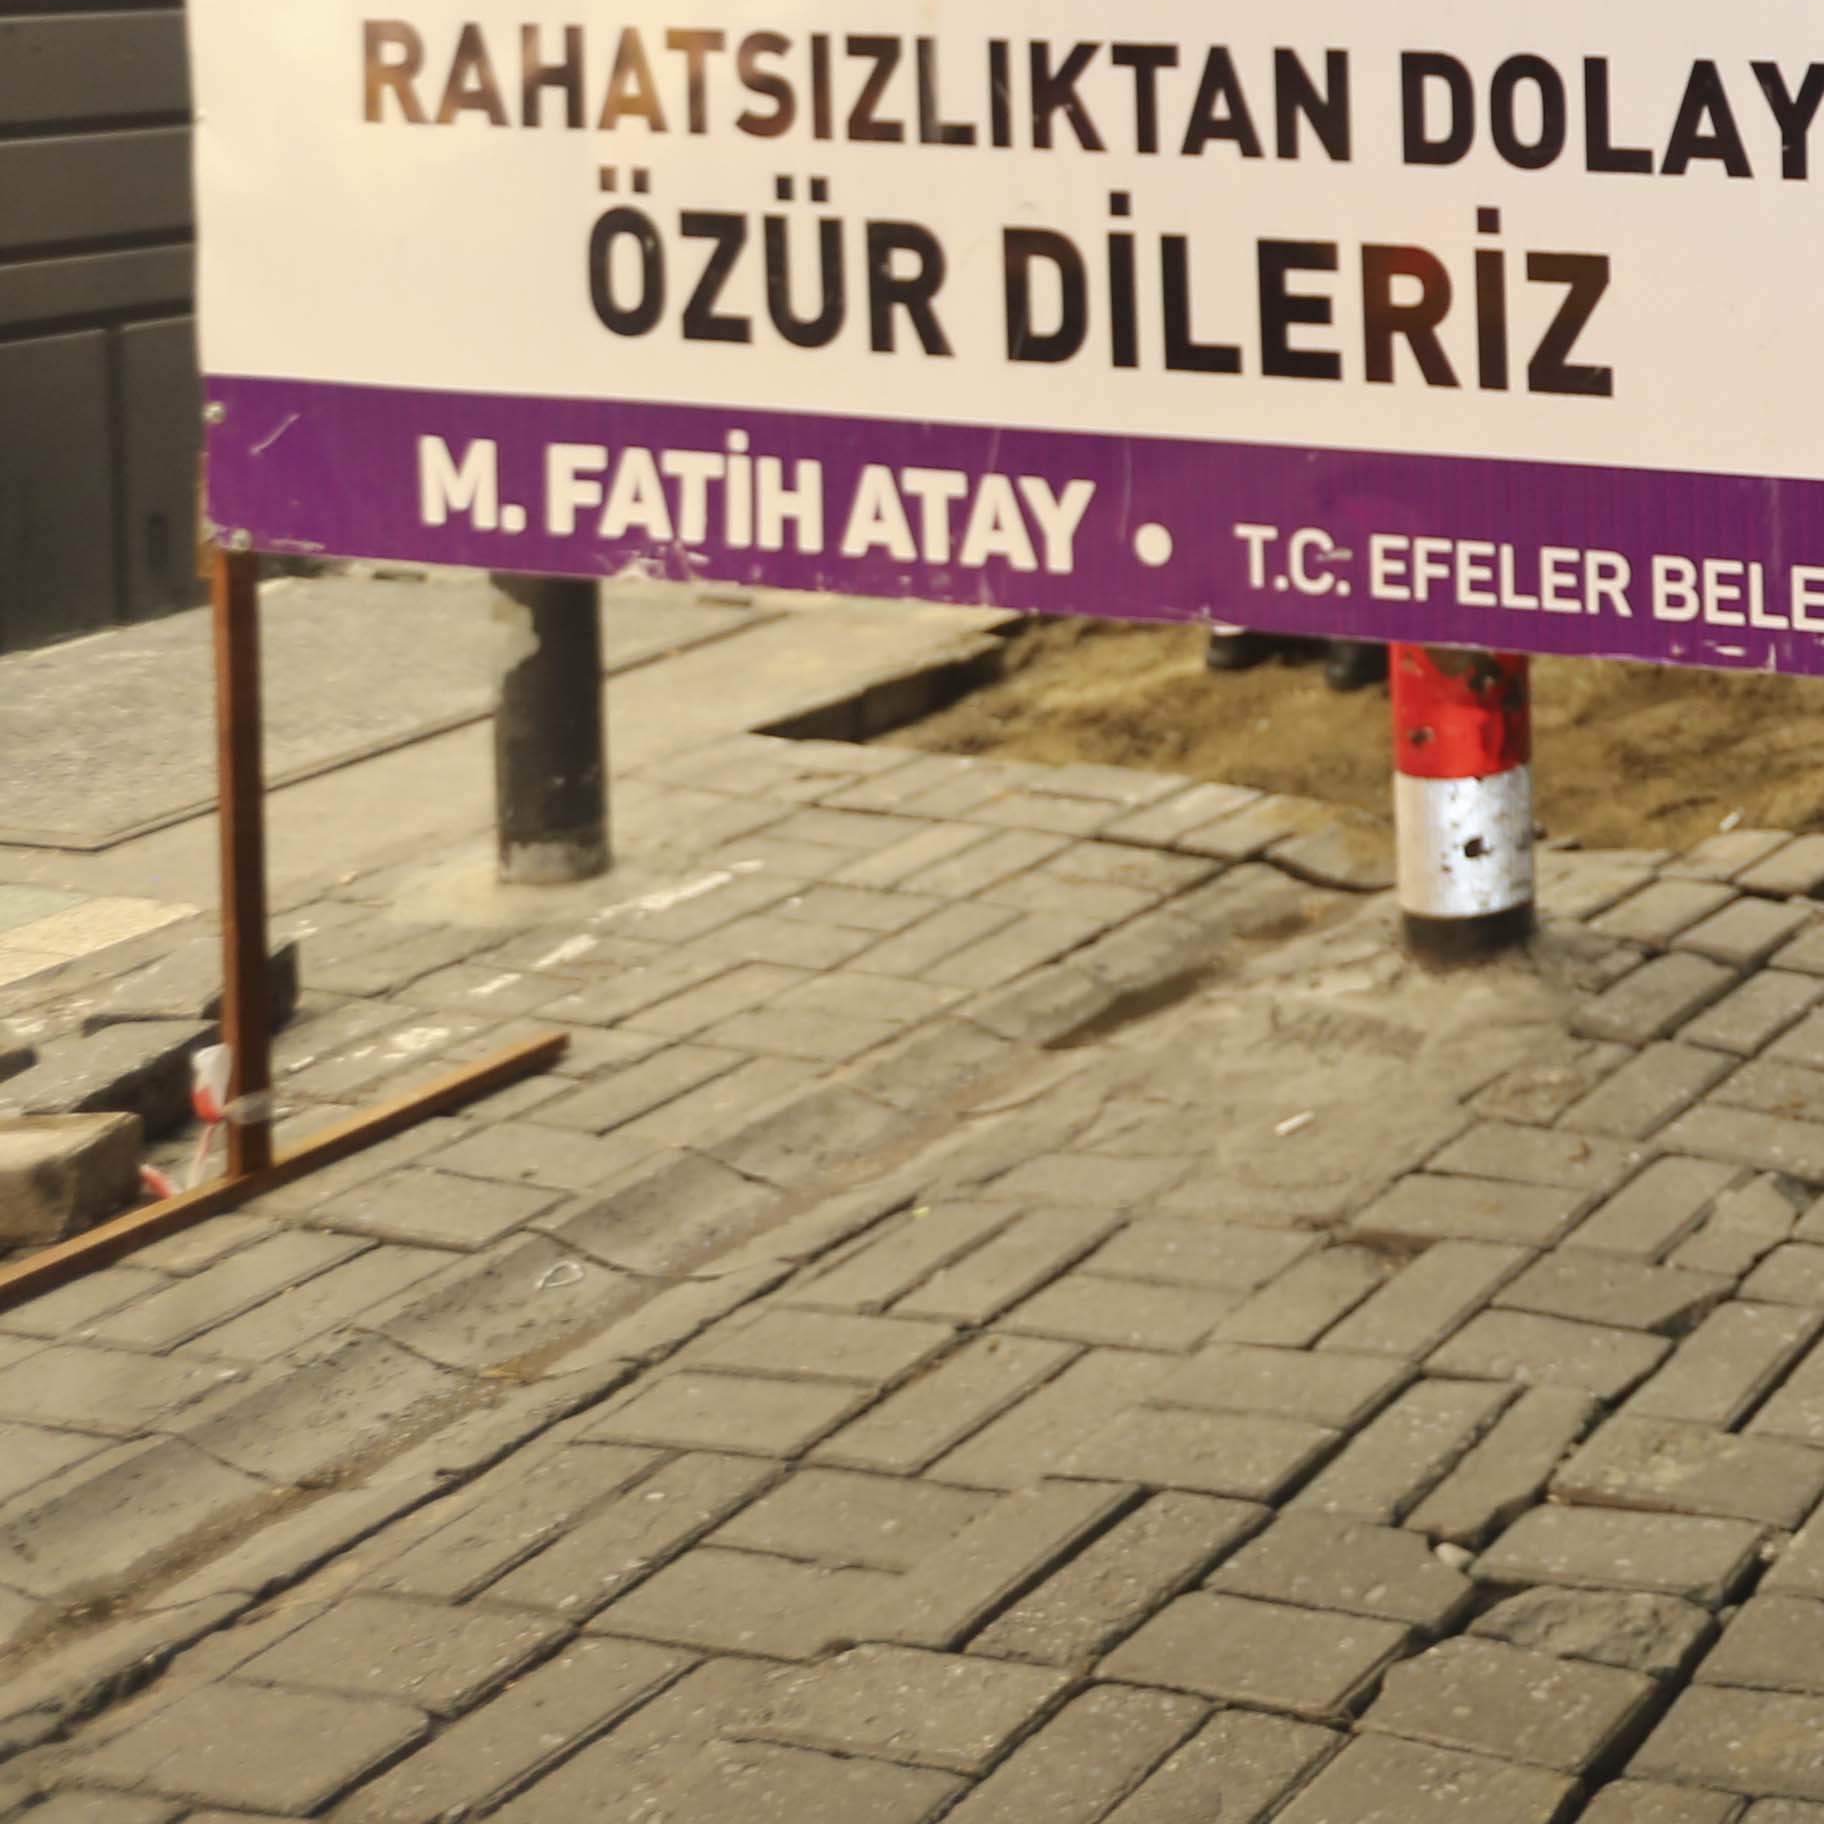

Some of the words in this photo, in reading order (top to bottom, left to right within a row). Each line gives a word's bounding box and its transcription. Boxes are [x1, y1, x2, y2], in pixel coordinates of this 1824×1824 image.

[361, 20, 1352, 162] RAHATSIZLIKTAN
[588, 167, 955, 357] ÖZÜR
[1002, 192, 1614, 398] DİLERİZ
[418, 434, 527, 533] M.
[545, 430, 825, 554] FATİH
[841, 465, 1097, 573] ATAY
[1233, 523, 1352, 597] T.C.
[1370, 534, 1633, 617] EFELER
